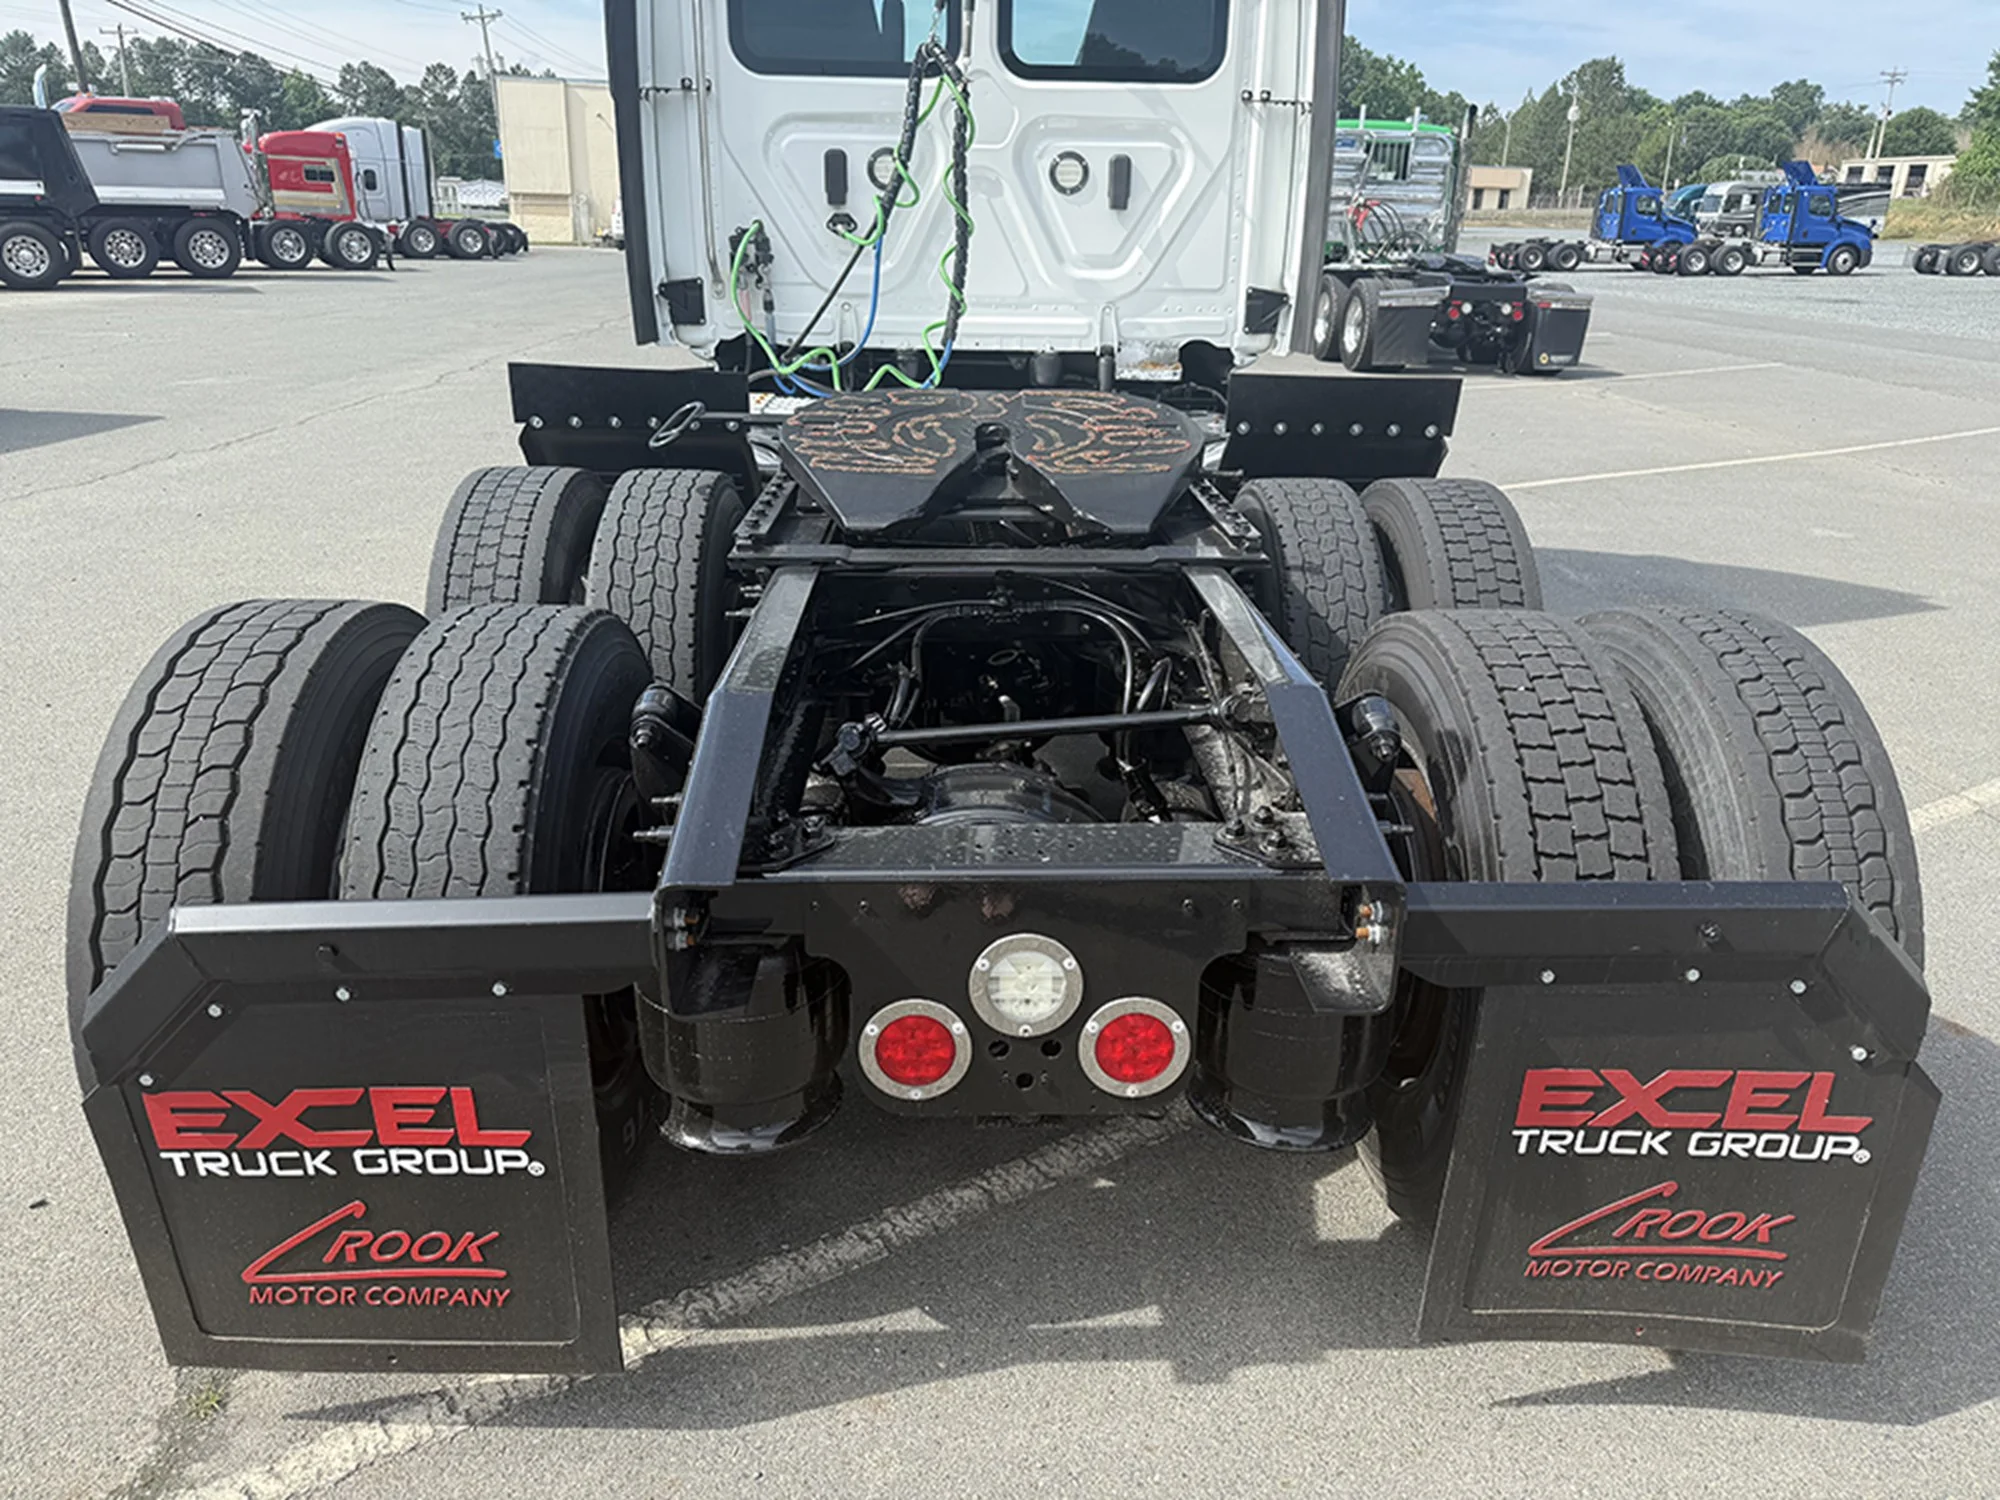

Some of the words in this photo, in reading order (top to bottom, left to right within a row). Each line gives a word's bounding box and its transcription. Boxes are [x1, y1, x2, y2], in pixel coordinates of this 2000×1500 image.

[1513, 1068, 1872, 1133] EXCEL
[142, 1087, 531, 1150] EXCEL
[1512, 1129, 1672, 1155] TRUCK
[159, 1150, 337, 1177] TRUCK
[1523, 1259, 1628, 1279] MOTOR
[1635, 1261, 1785, 1289] COMPANY
[249, 1286, 356, 1306] MOTOR
[363, 1286, 512, 1308] COMPANY
